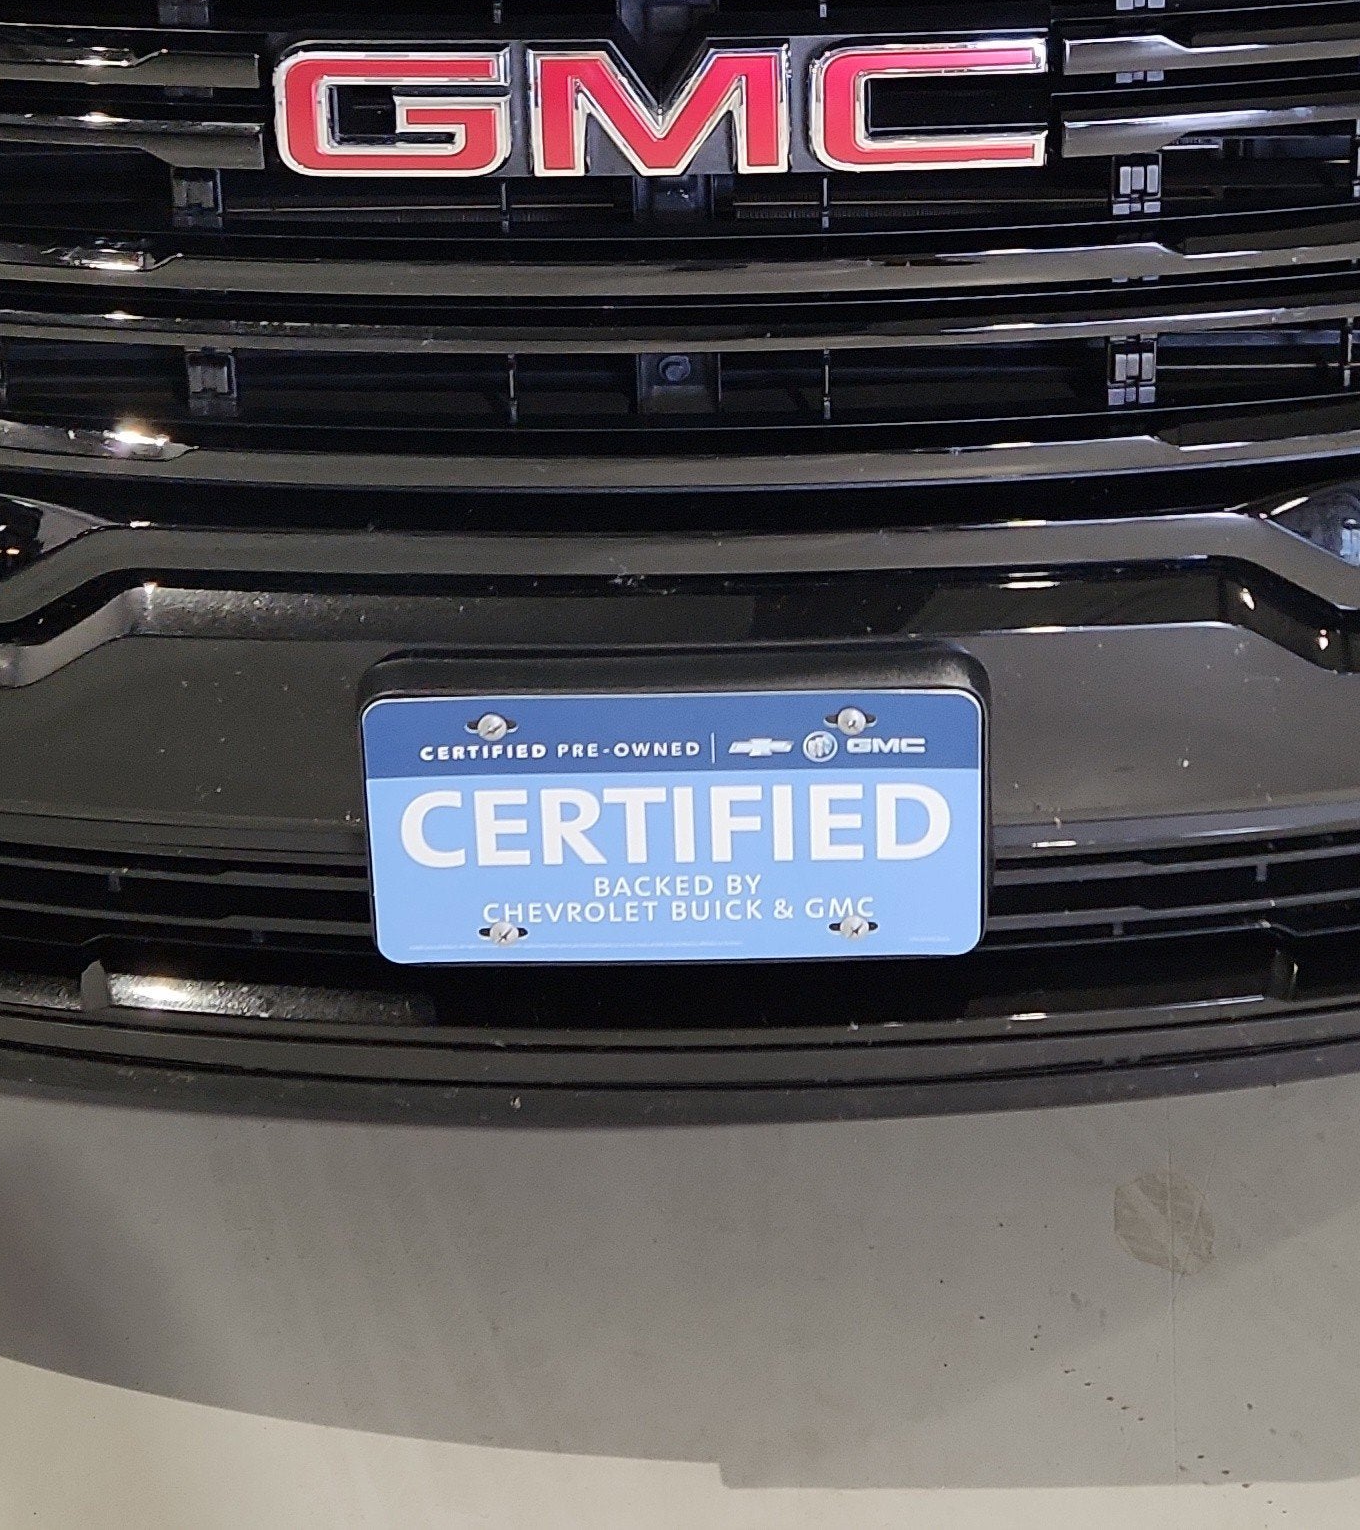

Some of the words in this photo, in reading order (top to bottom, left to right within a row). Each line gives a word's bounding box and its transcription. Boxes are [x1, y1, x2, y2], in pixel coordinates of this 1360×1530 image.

[273, 28, 1050, 178] GMC
[419, 743, 547, 761] CERTIFIED
[557, 741, 700, 758] PRE-OWNED
[846, 737, 926, 754] GMC
[400, 783, 952, 868] CERTIFIED
[594, 876, 714, 898] BACKED
[726, 873, 762, 896] BY
[482, 900, 659, 924] CHEVROLET
[670, 898, 763, 921] BUICK
[773, 898, 794, 919] &
[804, 896, 875, 919] GMC
